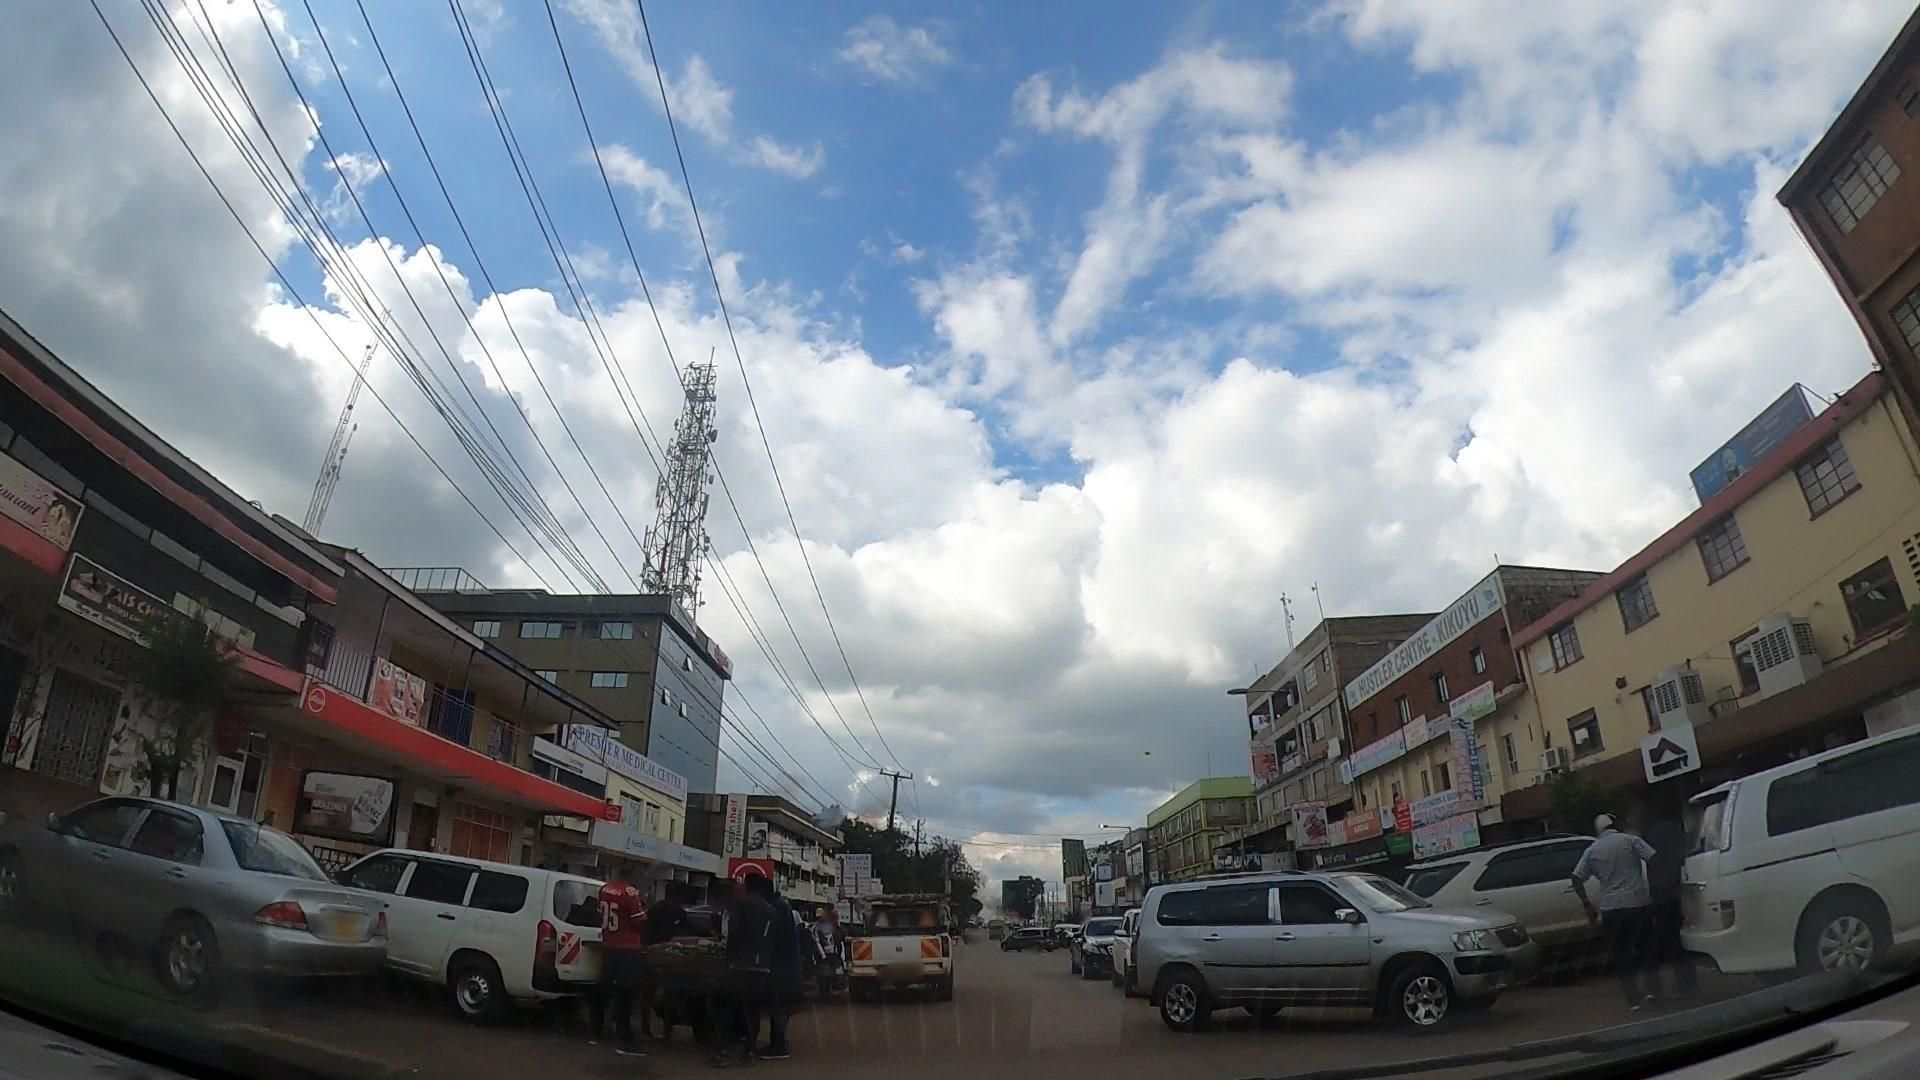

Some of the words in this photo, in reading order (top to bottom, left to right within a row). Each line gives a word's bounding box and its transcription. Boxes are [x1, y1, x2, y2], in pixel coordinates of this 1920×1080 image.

[1358, 659, 1395, 699] HUSTLER
[1394, 631, 1432, 673] CENTRE
[1435, 594, 1480, 643] KIKUYU
[621, 750, 656, 778] MEDICAL
